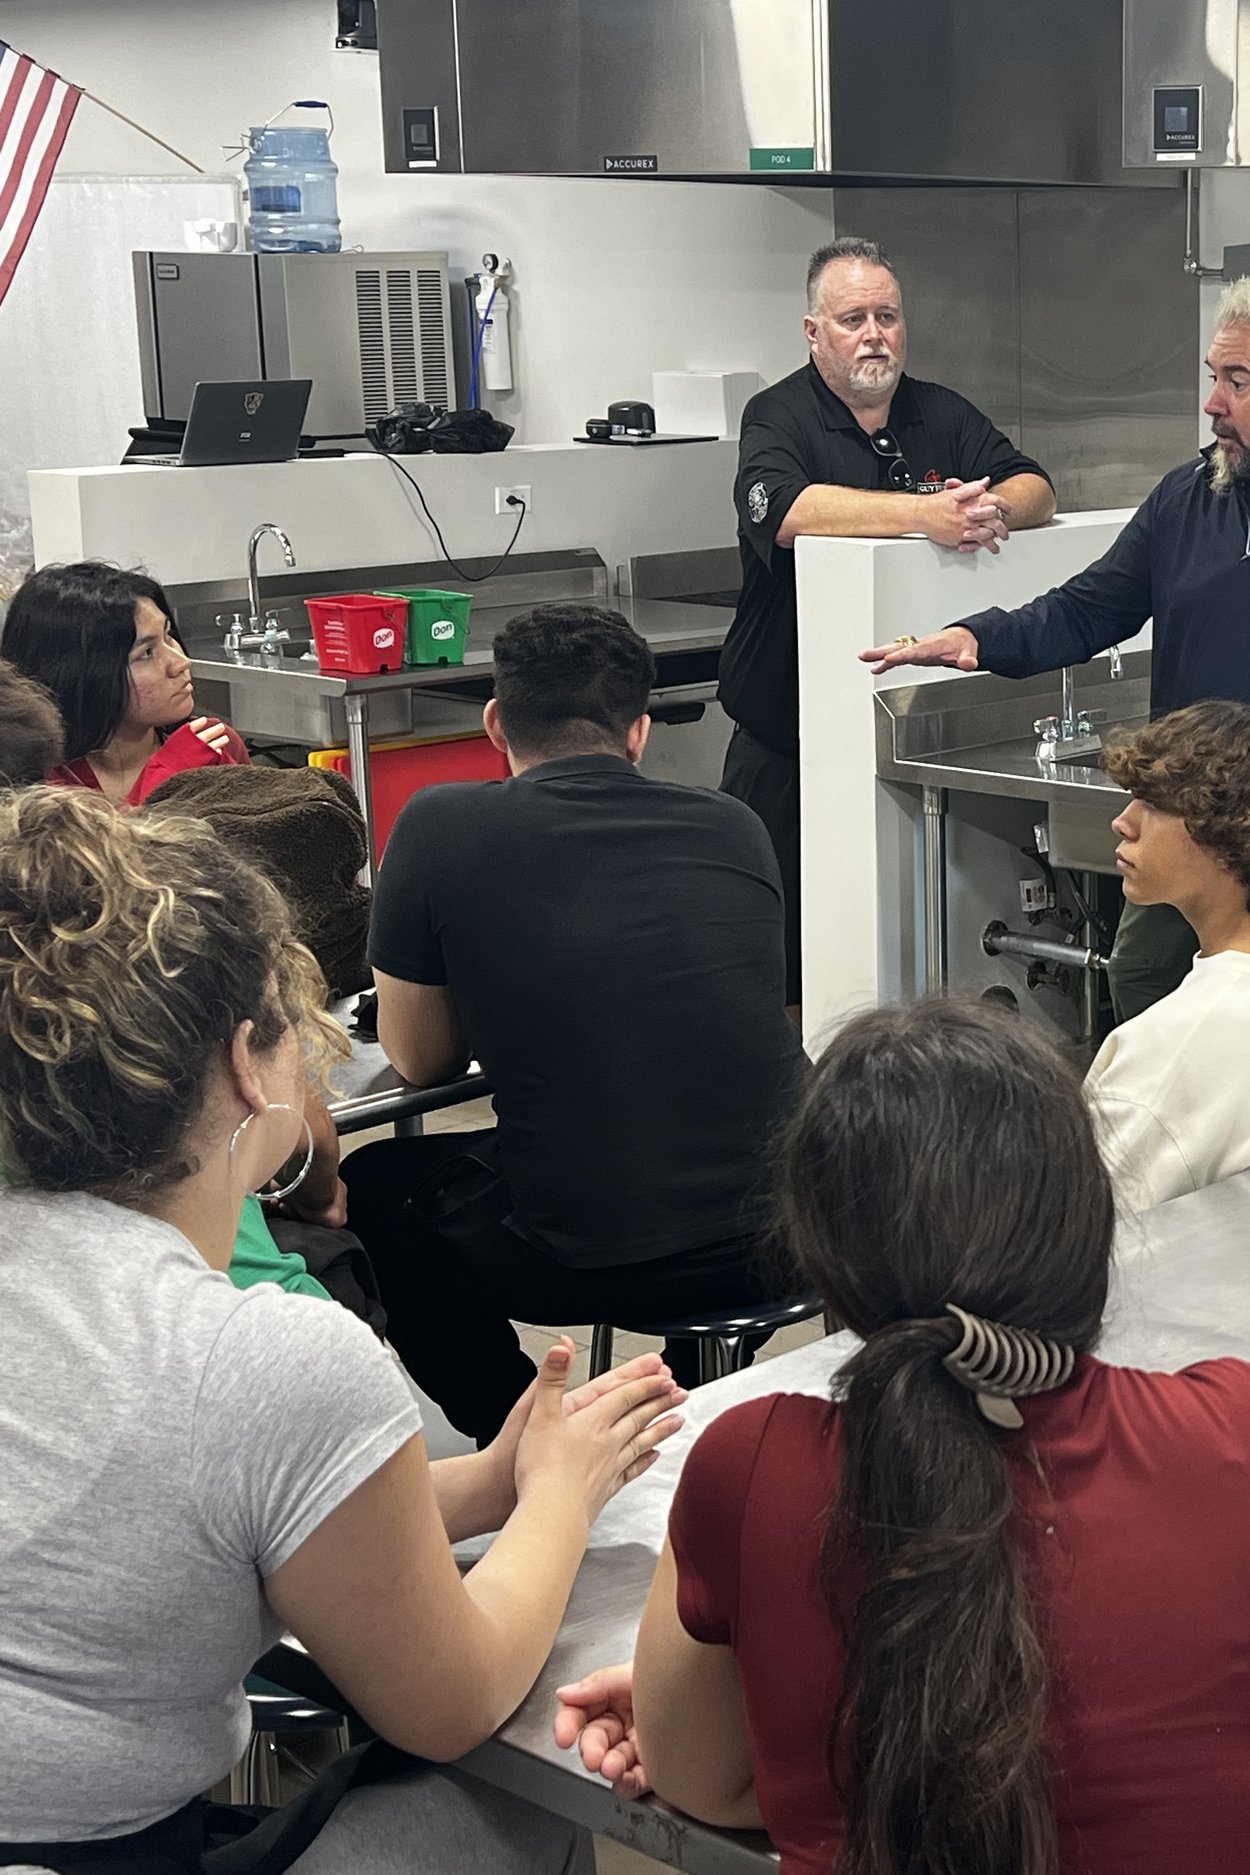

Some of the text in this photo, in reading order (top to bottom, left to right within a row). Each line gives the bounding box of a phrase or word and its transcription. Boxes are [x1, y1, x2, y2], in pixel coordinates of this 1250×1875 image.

[614, 159, 654, 168] ACCUREX
[771, 155, 786, 164] POD
[433, 623, 453, 637] Don
[375, 631, 393, 645] Don
